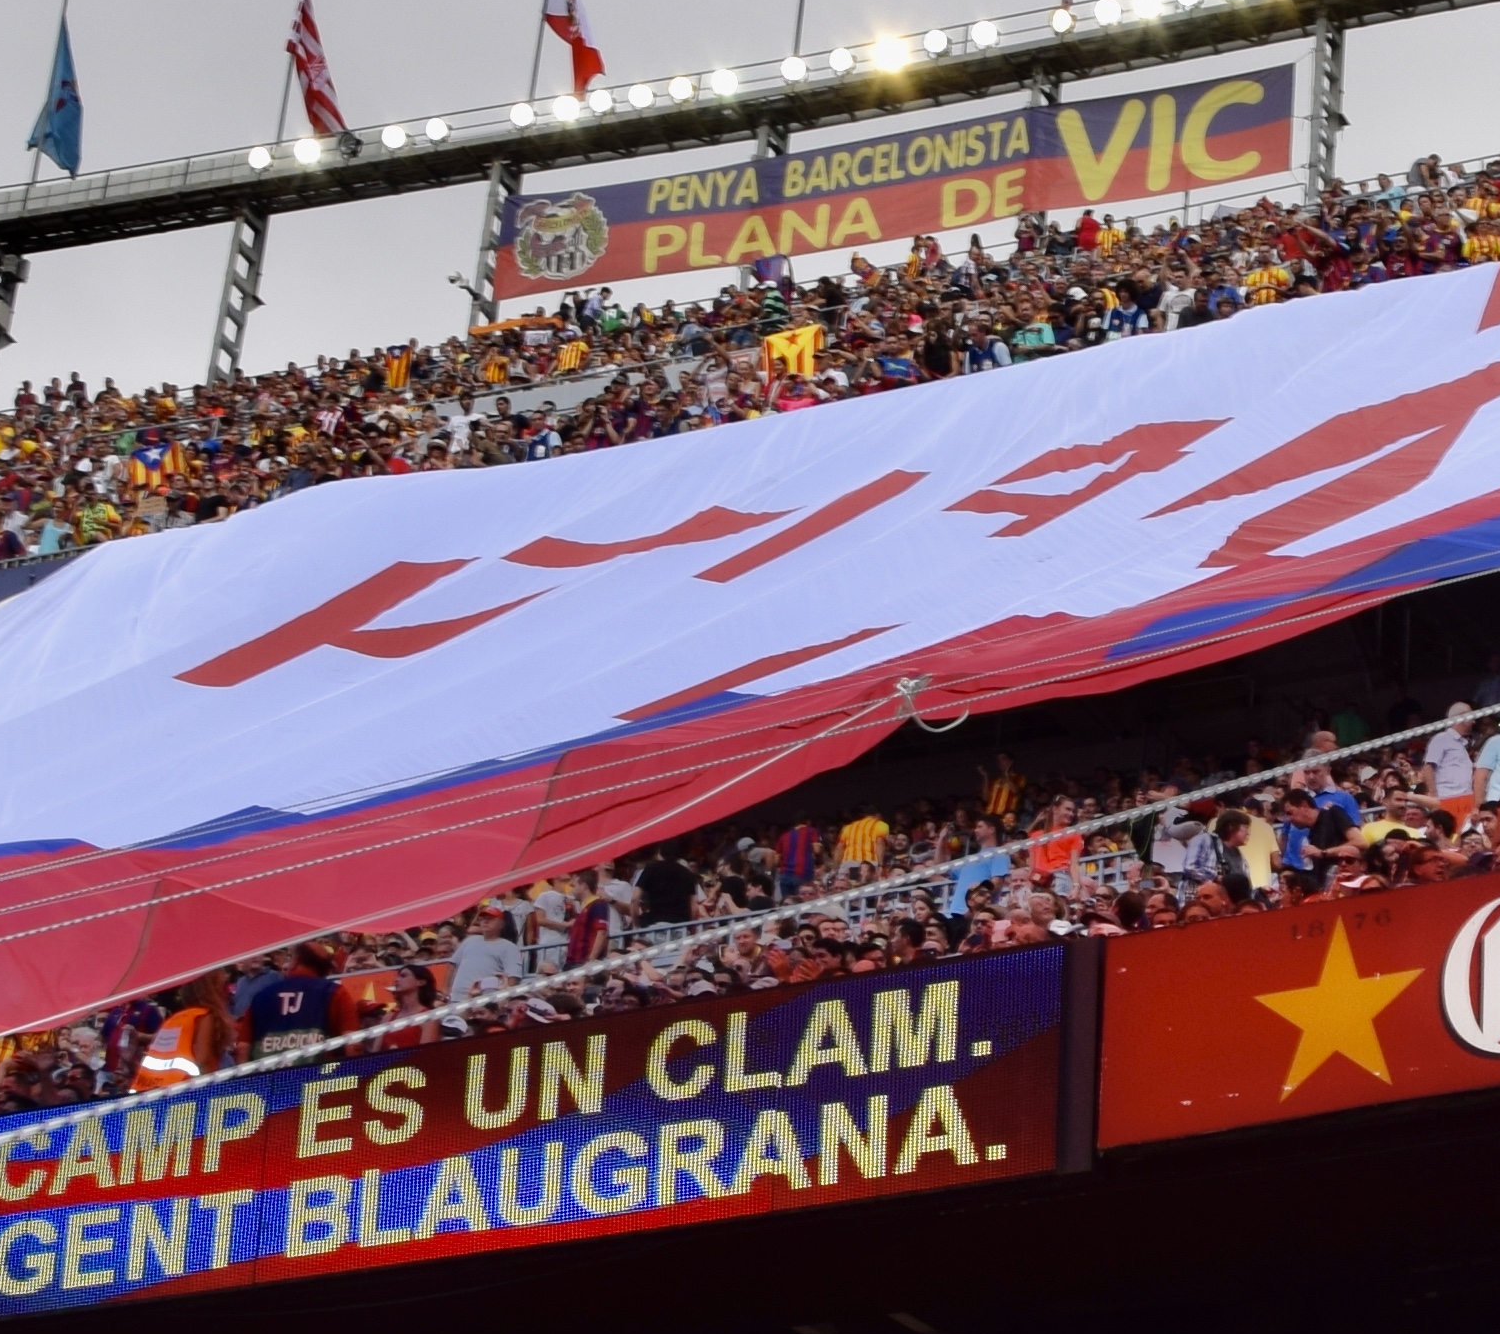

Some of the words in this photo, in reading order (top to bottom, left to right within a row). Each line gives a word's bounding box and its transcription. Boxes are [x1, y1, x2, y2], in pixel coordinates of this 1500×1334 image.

[642, 198, 882, 268] PLANA
[941, 174, 1026, 229] DE
[648, 168, 759, 214] PENYA
[782, 116, 1030, 197] BARCELONISTA
[1055, 79, 1264, 204] VIC
[298, 1060, 428, 1158] ÉS
[463, 1034, 608, 1130] UN
[645, 979, 993, 1103] CLAM.
[283, 1084, 1007, 1260] BLAUGRANA.
